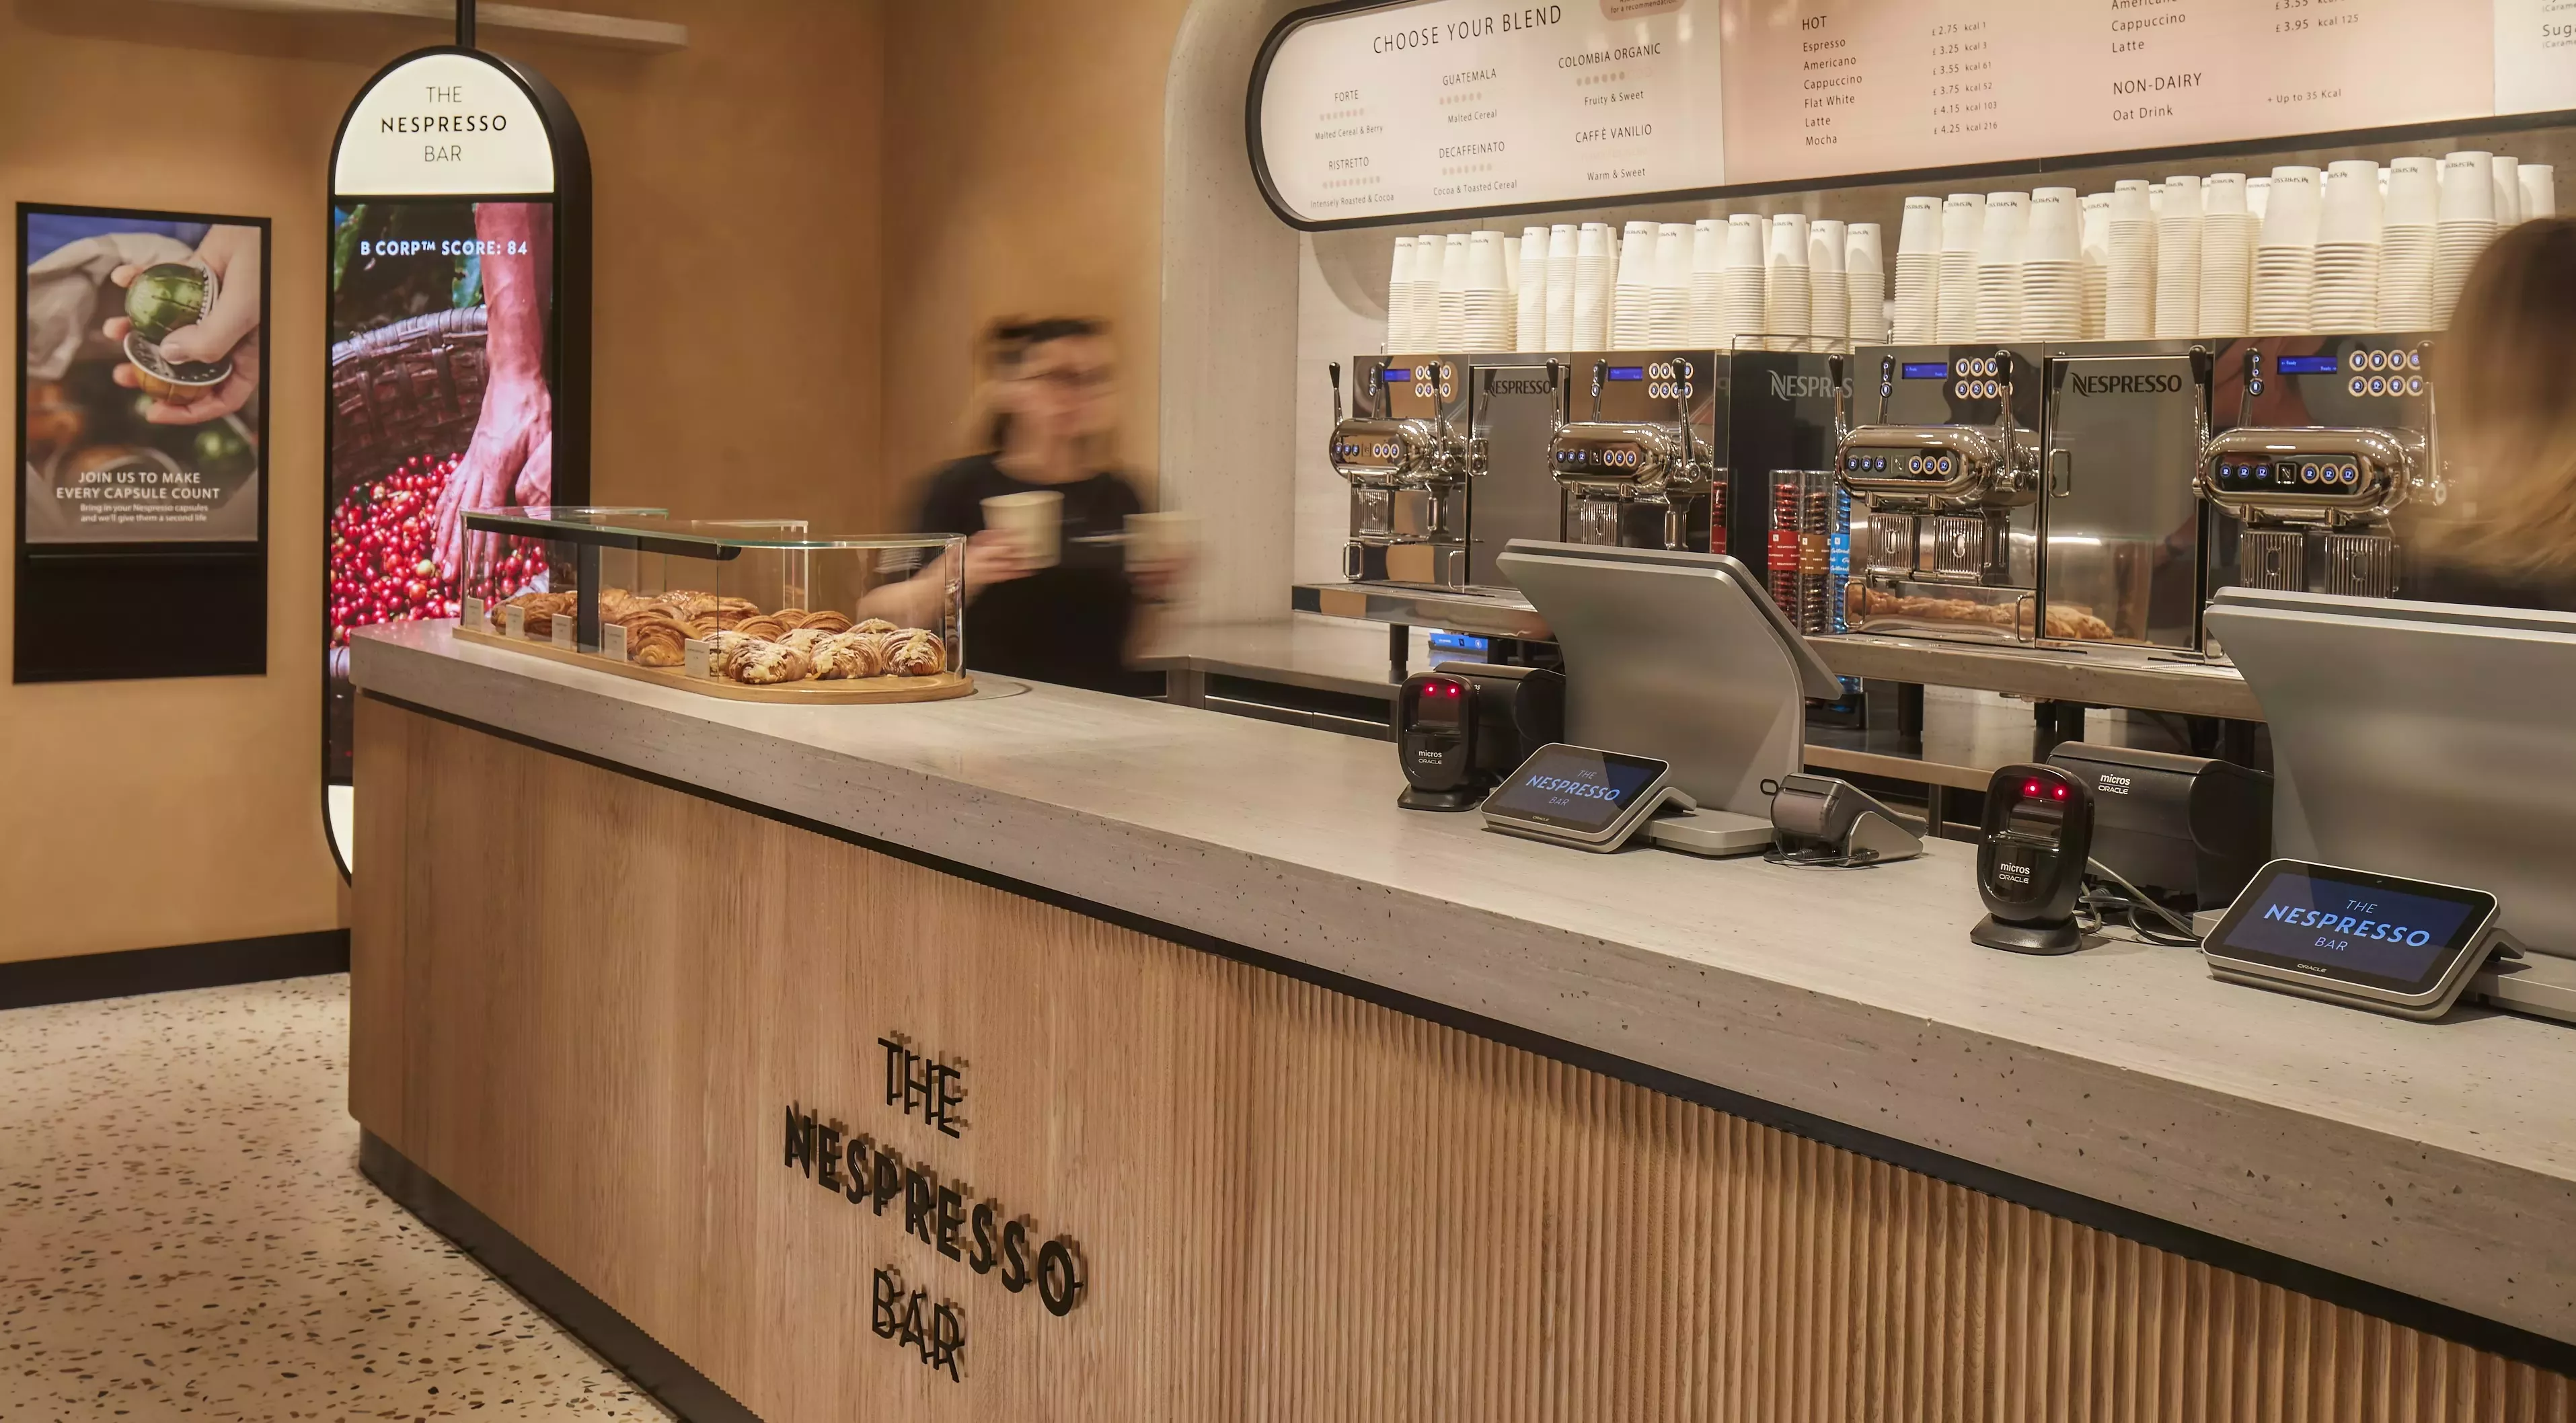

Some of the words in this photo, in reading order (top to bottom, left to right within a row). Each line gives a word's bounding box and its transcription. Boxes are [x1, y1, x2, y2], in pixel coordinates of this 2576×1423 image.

[1373, 26, 1439, 54] CHOOSE
[1447, 17, 1493, 41] YOUR
[1503, 5, 1561, 32] BLEND
[1803, 15, 1827, 30] HOT
[1939, 24, 1957, 35] 2.75
[1965, 22, 1979, 31] kcal
[2112, 14, 2185, 32] Cappuccino
[2284, 19, 2308, 32] 3.95
[2318, 16, 2337, 27] kcal
[2342, 14, 2358, 24] 125
[2542, 24, 2576, 38] Sug
[1803, 38, 1846, 52] Espresso
[1940, 44, 1959, 54] 3.25
[1965, 42, 1980, 51] kcal
[2113, 40, 2144, 53] Latte
[1558, 50, 1610, 69] COLOMBIA
[1614, 43, 1661, 61] ORGANIC
[1804, 56, 1856, 71] Americano
[1940, 64, 1959, 75] 3.55
[1965, 62, 1980, 71] kcal
[1983, 61, 1991, 69] 61
[1443, 69, 1497, 85] GUATEMALA
[1804, 75, 1862, 91] Cappuccino
[2113, 73, 2202, 94] NON-DAIRY
[426, 87, 462, 103] THE
[1334, 89, 1359, 102] FORTE
[1940, 85, 1959, 95] 3.75
[1965, 83, 1980, 91] kcal
[2277, 95, 2289, 104] Up
[2306, 91, 2317, 100] 35
[2322, 88, 2341, 98] Kcal
[1585, 95, 1607, 107] Fruity
[1610, 93, 1616, 102] &
[1618, 90, 1644, 102] Sweet
[1805, 98, 1823, 108] Flat
[1826, 95, 1855, 106] White
[1940, 104, 1959, 114] 4.15
[1966, 103, 1981, 112] kcal
[1983, 102, 1997, 110] 103
[2113, 109, 2133, 121] Oat
[2139, 106, 2172, 118] Drink
[382, 116, 506, 132] NESPRESSO
[1448, 113, 1472, 124] Malted
[1474, 110, 1497, 121] Cereal
[1805, 116, 1831, 127] Latte
[1315, 130, 1336, 140] Malted
[1338, 127, 1358, 137] Cereal
[1360, 126, 1364, 134] &
[1367, 125, 1383, 134] Berry
[1575, 127, 1607, 143] CAFFÈ
[1610, 124, 1652, 139] VANILIO
[1941, 124, 1960, 134] 4.25
[1966, 123, 1981, 132] kcal
[1983, 122, 1998, 130] 216
[1806, 134, 1838, 146] Mocha
[425, 146, 461, 161] BAR
[1439, 141, 1505, 159] DECAFFEINATO
[1329, 157, 1369, 170] RISTRETTO
[1587, 171, 1609, 181] Warm
[1613, 169, 1618, 179] &
[1621, 167, 1645, 178] Sweet
[1433, 186, 1454, 196] Cocoa
[1457, 185, 1462, 193] &
[1463, 182, 1492, 193] Toasted
[1494, 180, 1517, 190] Cereal
[1311, 198, 1338, 208] Intensely
[1341, 195, 1365, 205] Roasted
[1375, 194, 1394, 202] Cocoa
[361, 241, 370, 255] B
[442, 241, 501, 256] SCORE:
[508, 241, 527, 255] 84
[1767, 369, 1853, 401] NESPRS
[2070, 373, 2182, 396] NESPRESSO
[79, 472, 112, 484] JOIN
[117, 473, 135, 484] US
[139, 473, 157, 484] TO
[162, 473, 201, 484] MAKE
[56, 488, 101, 498] EVERY
[104, 488, 167, 499] CAPSULE
[172, 488, 221, 499] COUNT
[80, 504, 101, 513] Bring
[133, 504, 174, 513] Nespresso
[174, 504, 209, 513] capsules
[117, 514, 134, 524] give
[195, 514, 206, 522] life
[1418, 750, 1442, 759] micros
[1577, 770, 1597, 779] THE
[2100, 774, 2131, 785] micros
[1525, 775, 1620, 802] NESPRESSO
[2098, 785, 2129, 795] ORACLE
[1549, 797, 1569, 806] BAR
[2000, 863, 2030, 874] micros
[1999, 874, 2029, 884] ORACLE
[2346, 900, 2378, 914] THE
[2263, 904, 2430, 948] NESPRESSO
[2314, 937, 2348, 952] BAR
[2297, 963, 2326, 973] ORACLE
[878, 1037, 960, 1139] THE
[784, 1105, 1075, 1317] NESPRESSO
[872, 1267, 960, 1383] BAR
